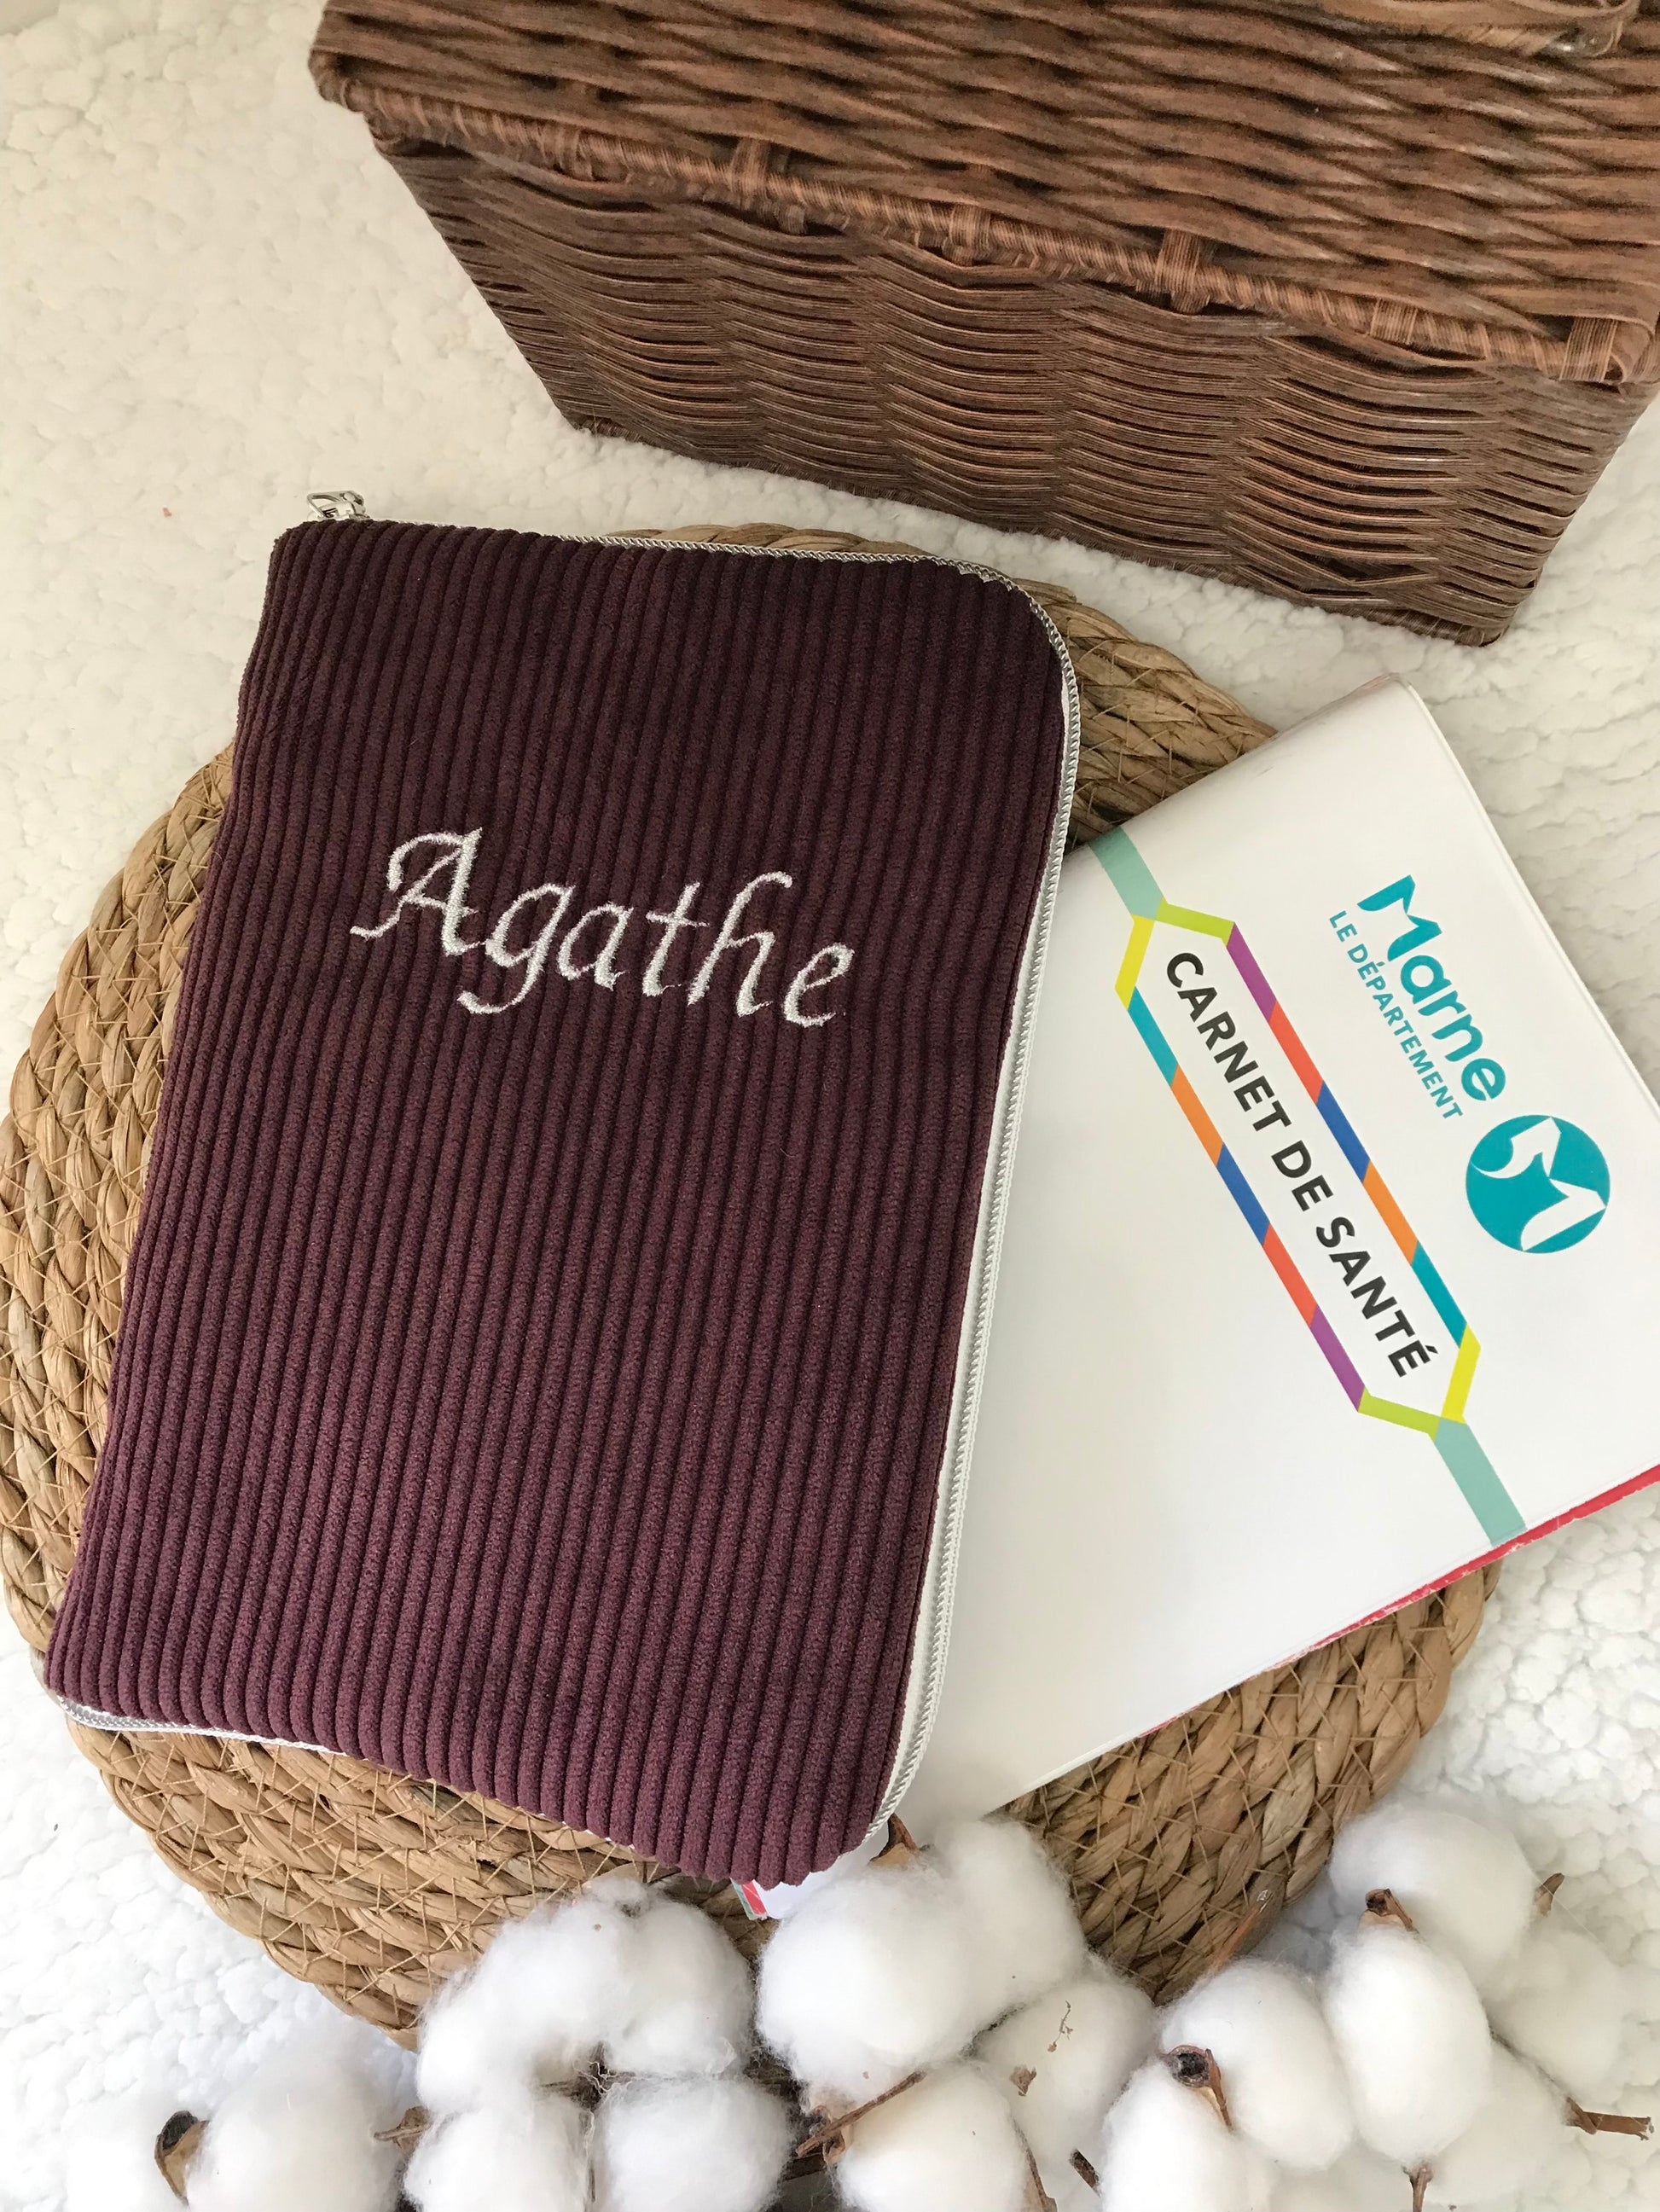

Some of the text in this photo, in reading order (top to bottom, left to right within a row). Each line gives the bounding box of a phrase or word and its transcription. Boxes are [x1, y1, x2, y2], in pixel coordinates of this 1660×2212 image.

[350, 827, 854, 1027] Agathe
[1329, 910, 1463, 1119] LE DÉPARTEMENT
[1356, 874, 1506, 1101] Marne
[1166, 951, 1438, 1378] CARNET DE SANTÉ
